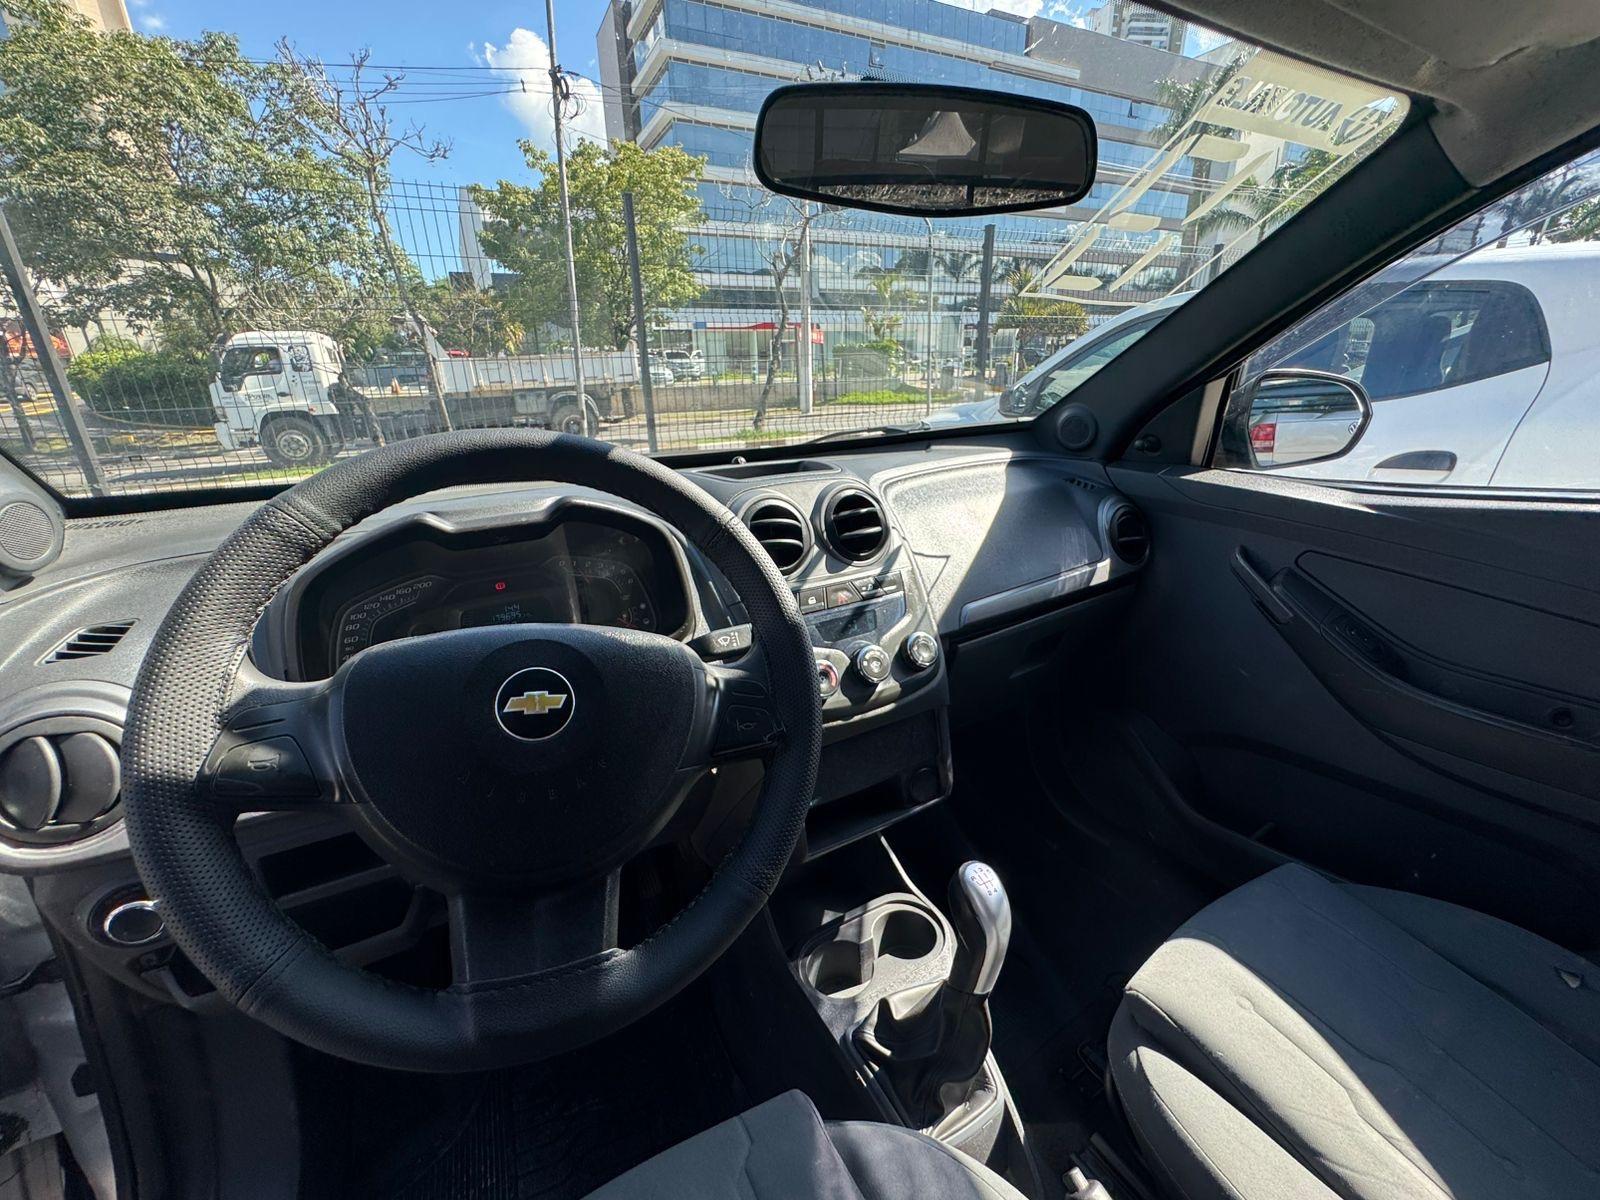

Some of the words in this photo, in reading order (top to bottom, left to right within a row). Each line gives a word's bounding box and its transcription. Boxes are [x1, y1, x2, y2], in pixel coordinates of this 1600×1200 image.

[412, 581, 432, 590] 200
[395, 587, 412, 595] 160
[379, 594, 396, 602] 140
[363, 602, 380, 610] 120
[350, 612, 367, 620] 100
[345, 623, 360, 631] 80
[344, 636, 359, 644] 60
